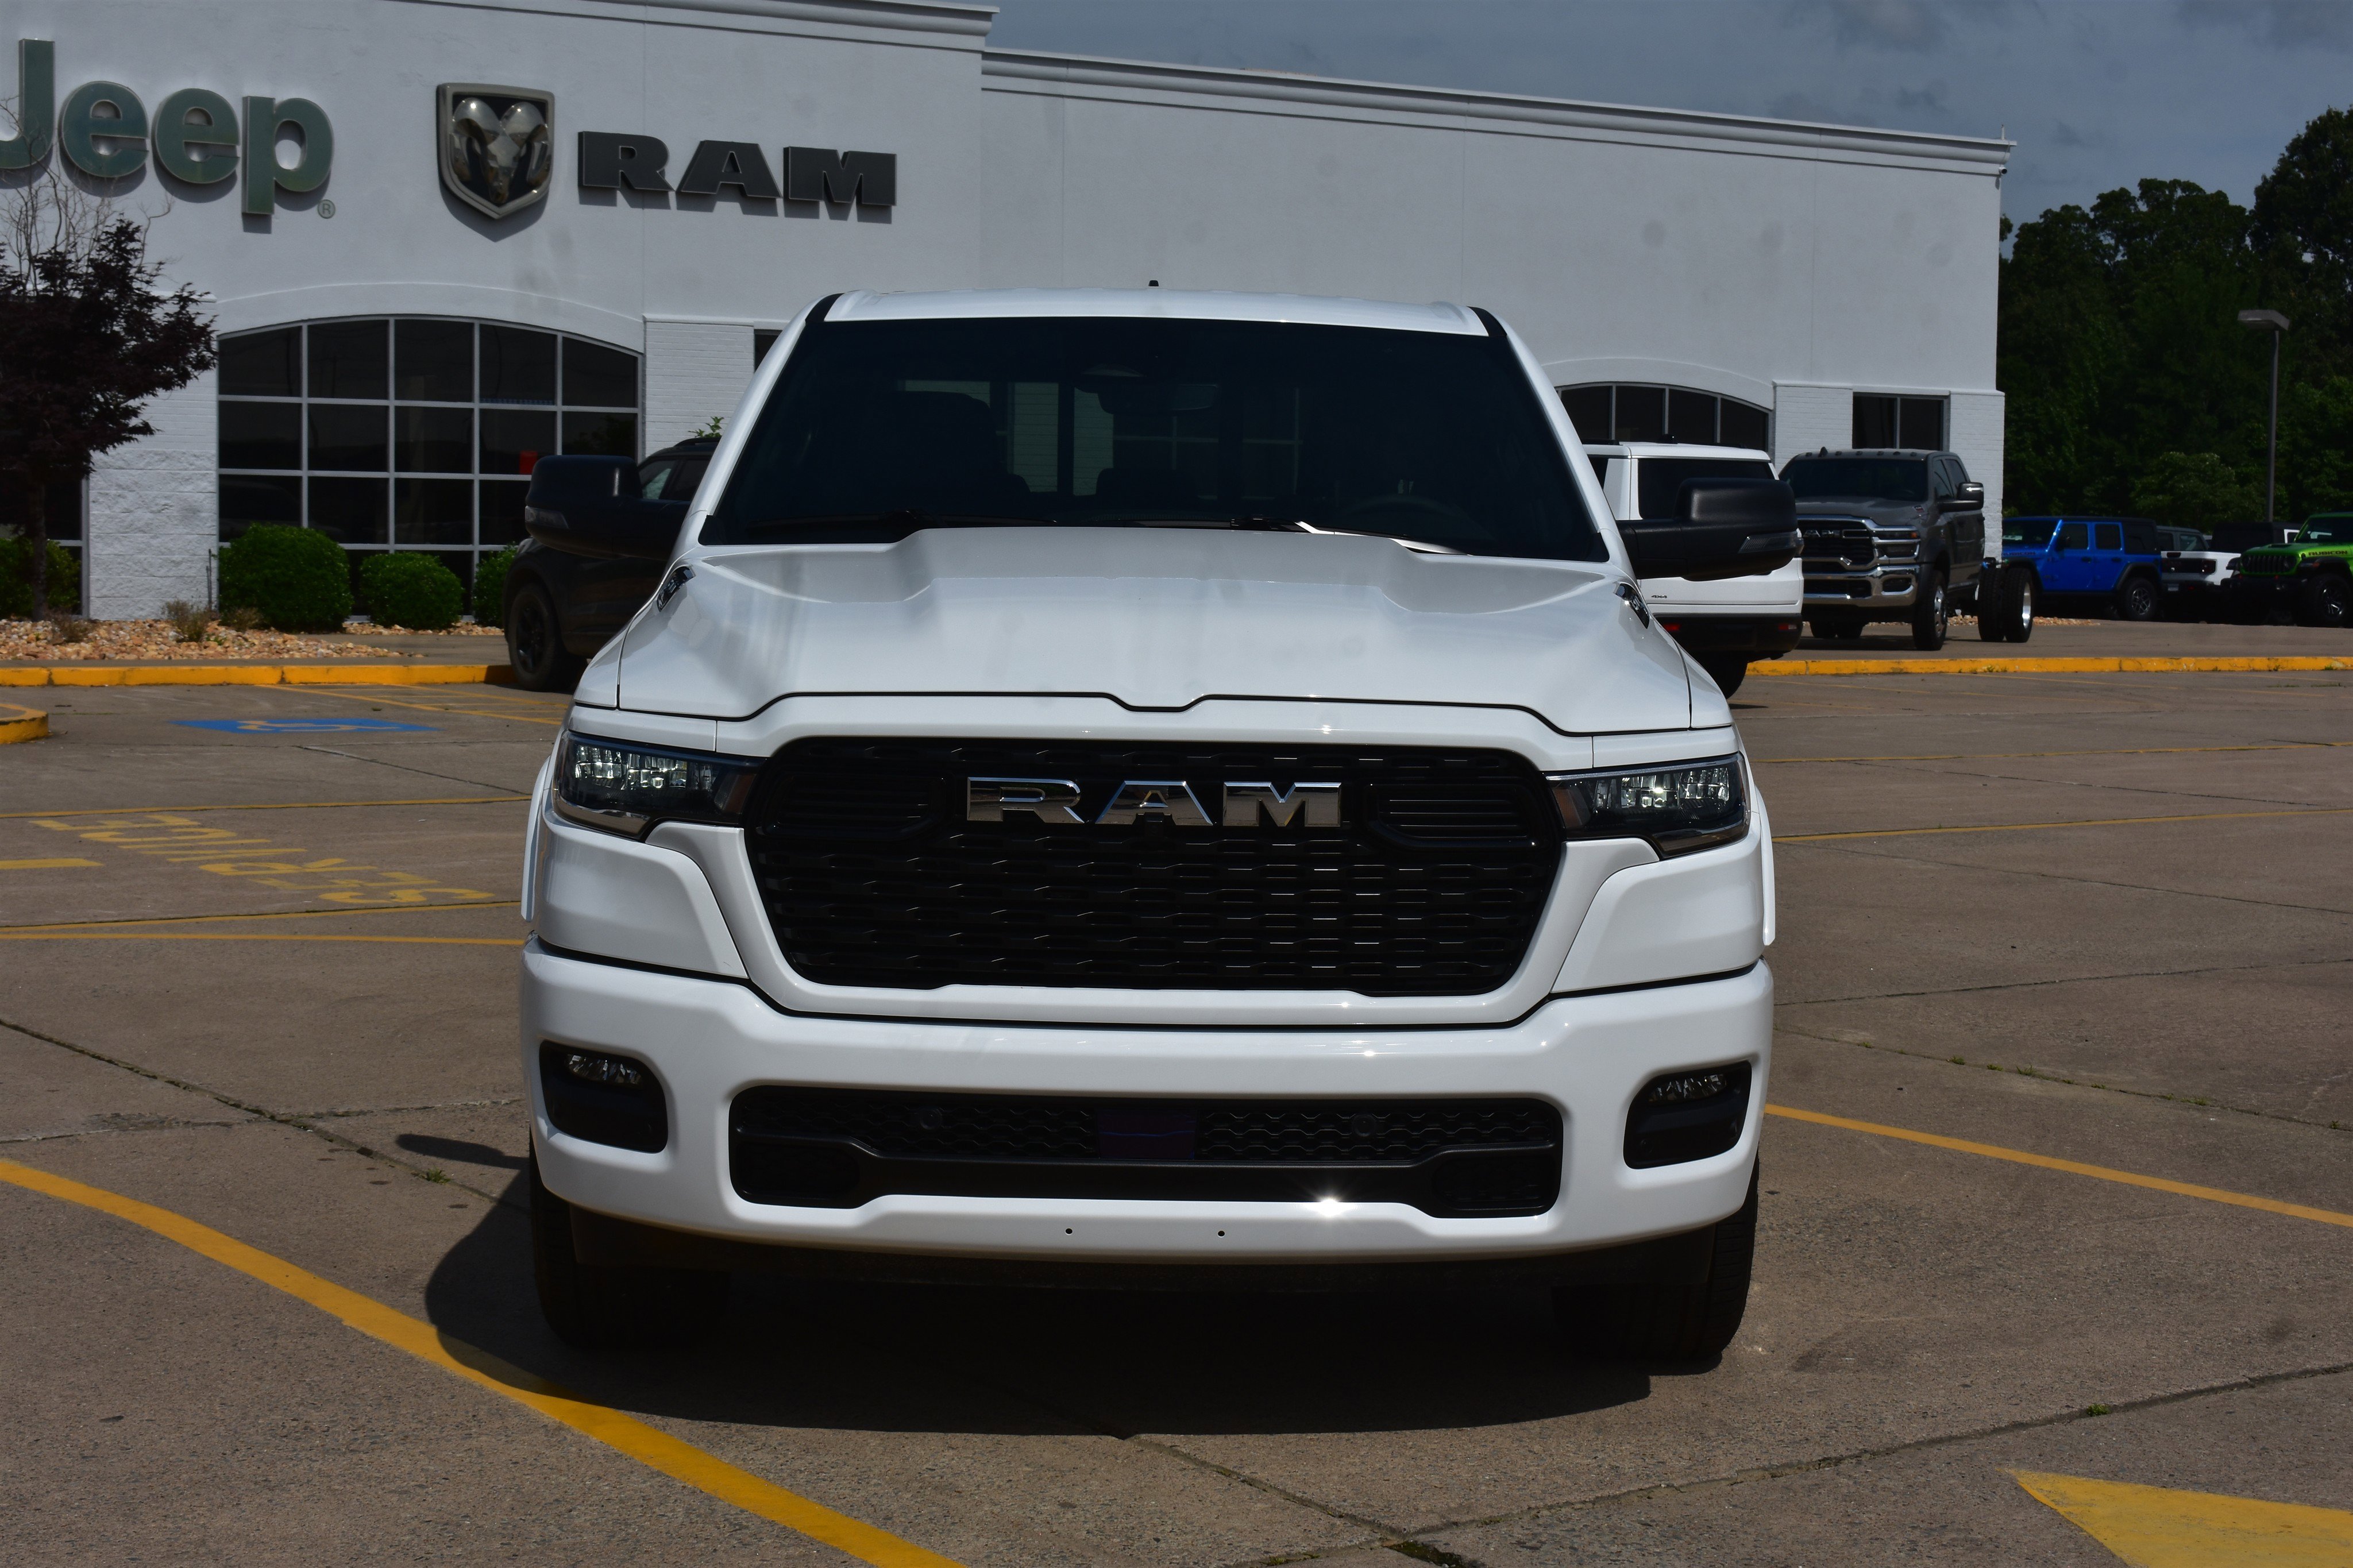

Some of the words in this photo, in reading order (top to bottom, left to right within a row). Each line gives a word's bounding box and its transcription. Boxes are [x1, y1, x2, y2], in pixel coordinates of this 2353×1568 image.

[0, 38, 334, 215] Jeep
[578, 131, 897, 206] RAM
[967, 777, 1342, 827] RAM
